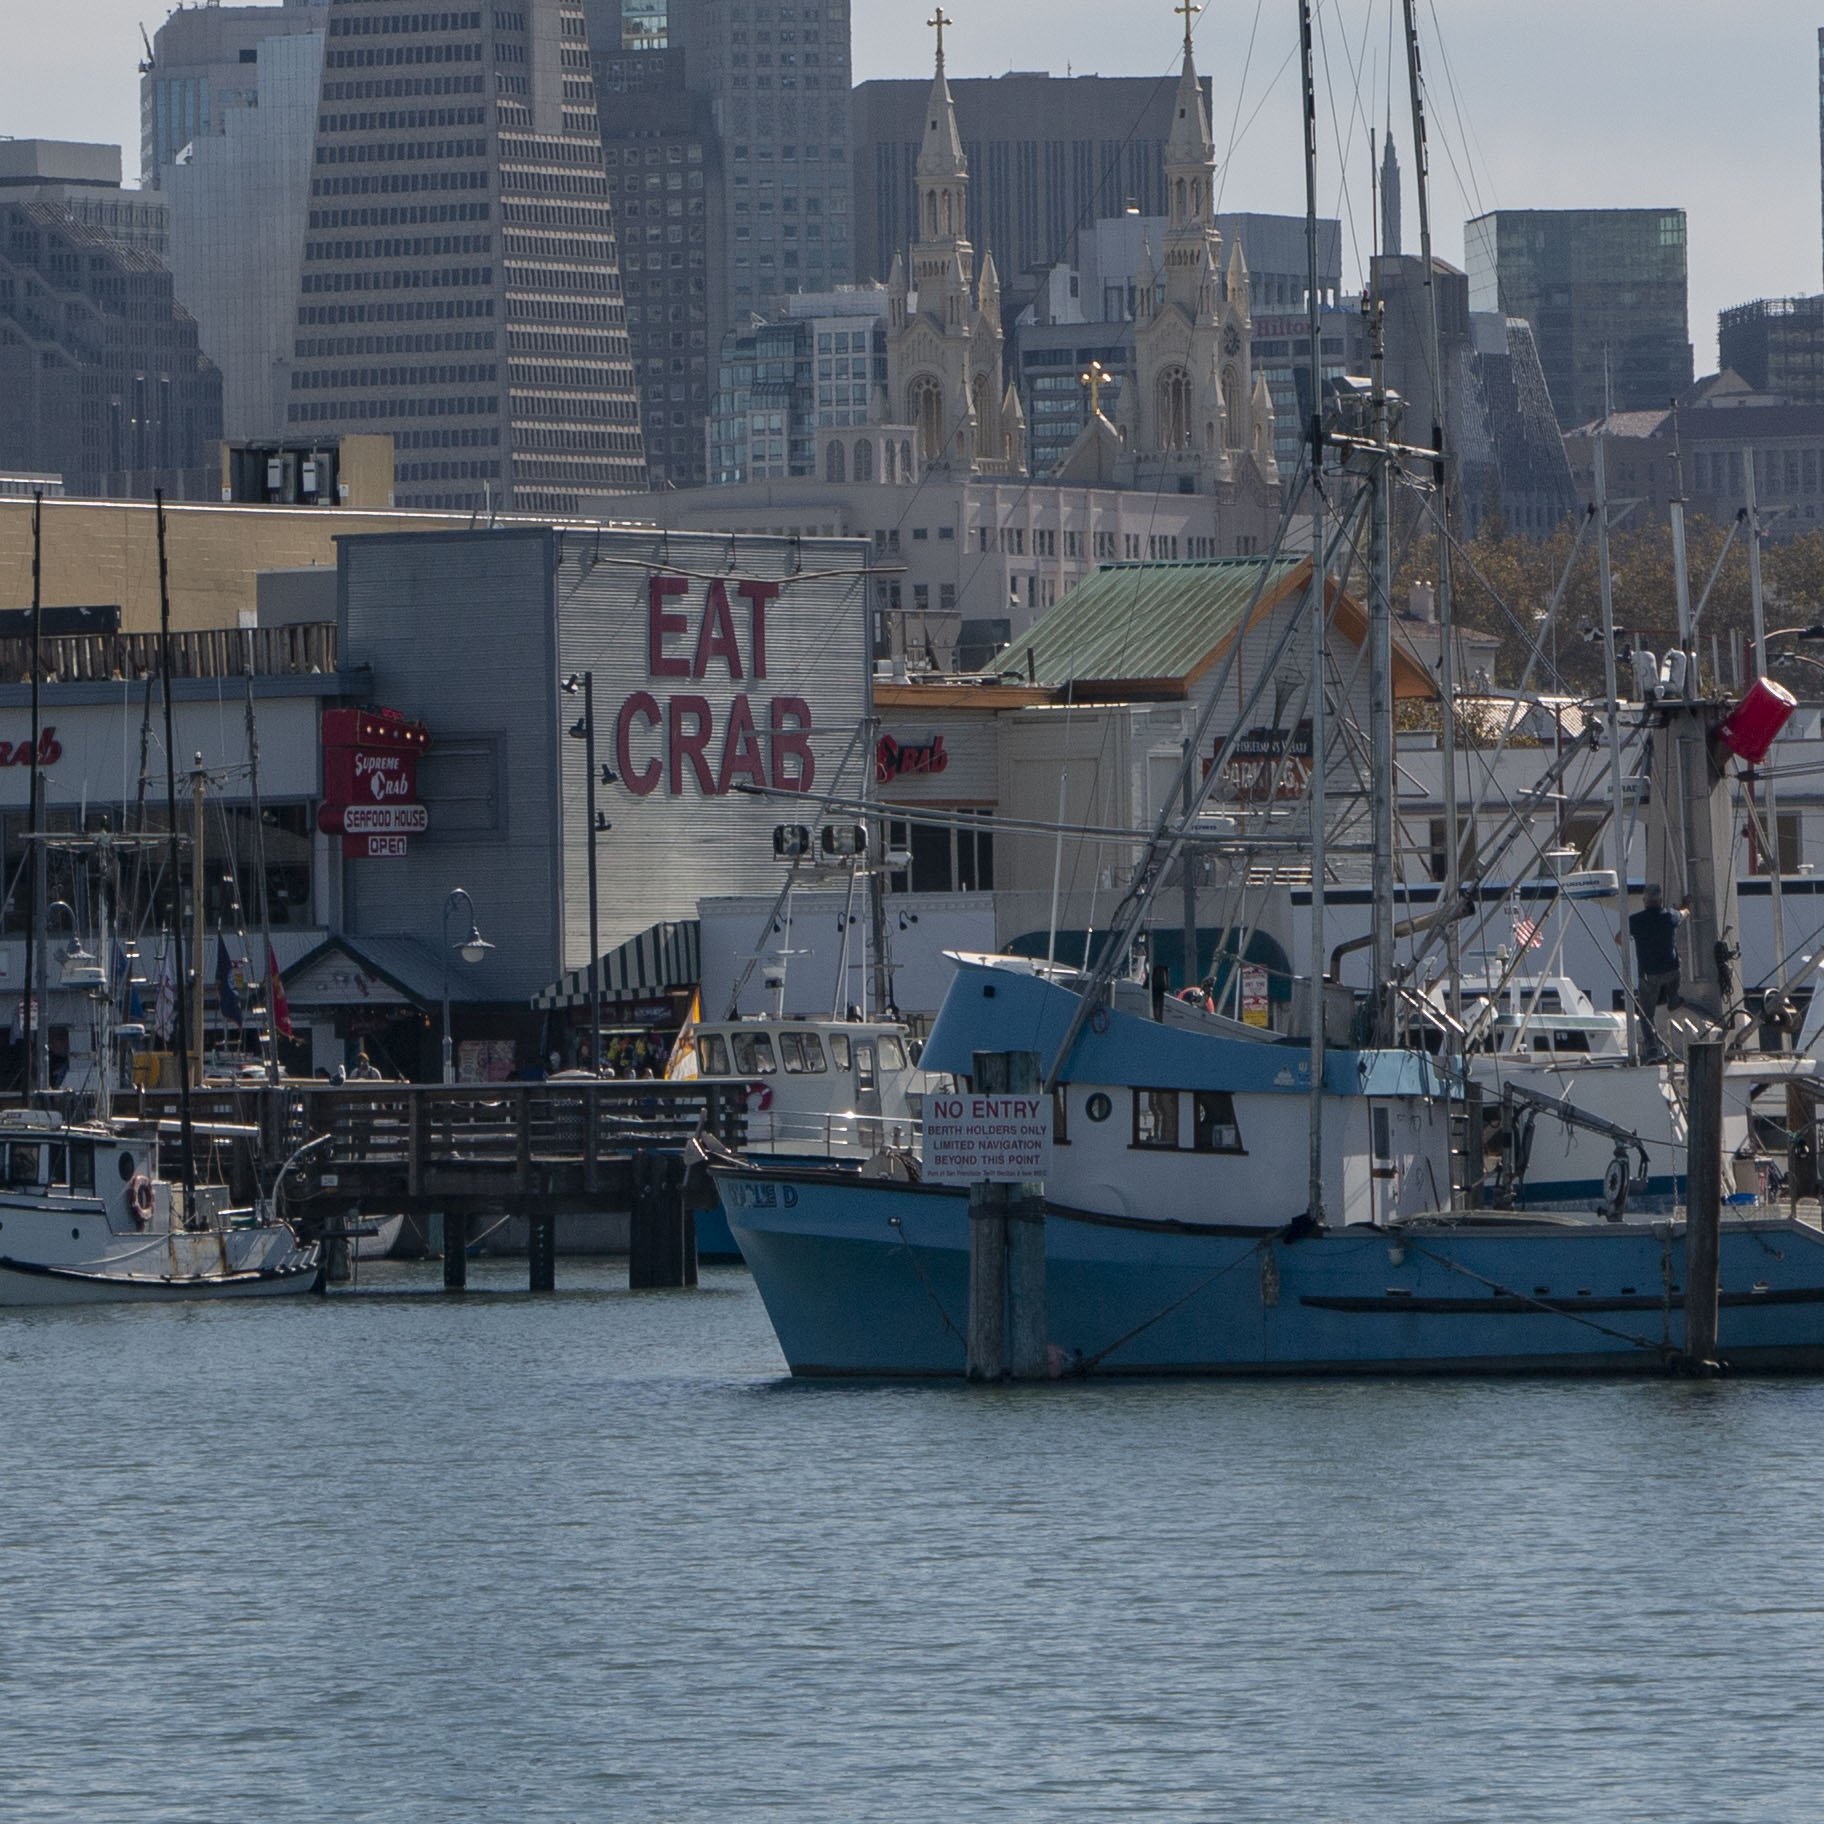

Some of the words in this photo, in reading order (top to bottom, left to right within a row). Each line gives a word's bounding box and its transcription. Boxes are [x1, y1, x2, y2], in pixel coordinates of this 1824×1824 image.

[649, 577, 779, 679] EAT
[616, 690, 816, 797] CRAB
[346, 809, 391, 828] SEAFOOD
[394, 809, 426, 827] HOUSE
[369, 837, 405, 854] OPEN
[934, 1100, 963, 1119] NO
[972, 1100, 1040, 1118] ENTRY
[928, 1125, 962, 1135] BERTH
[966, 1125, 1017, 1135] HOLDERS
[1020, 1125, 1047, 1135] ONLY
[933, 1140, 975, 1150] LIMITED
[978, 1140, 1042, 1150] NAVIGATION
[934, 1155, 977, 1165] BEYOND
[982, 1155, 1005, 1165] THIS
[1009, 1155, 1040, 1165] POINT
